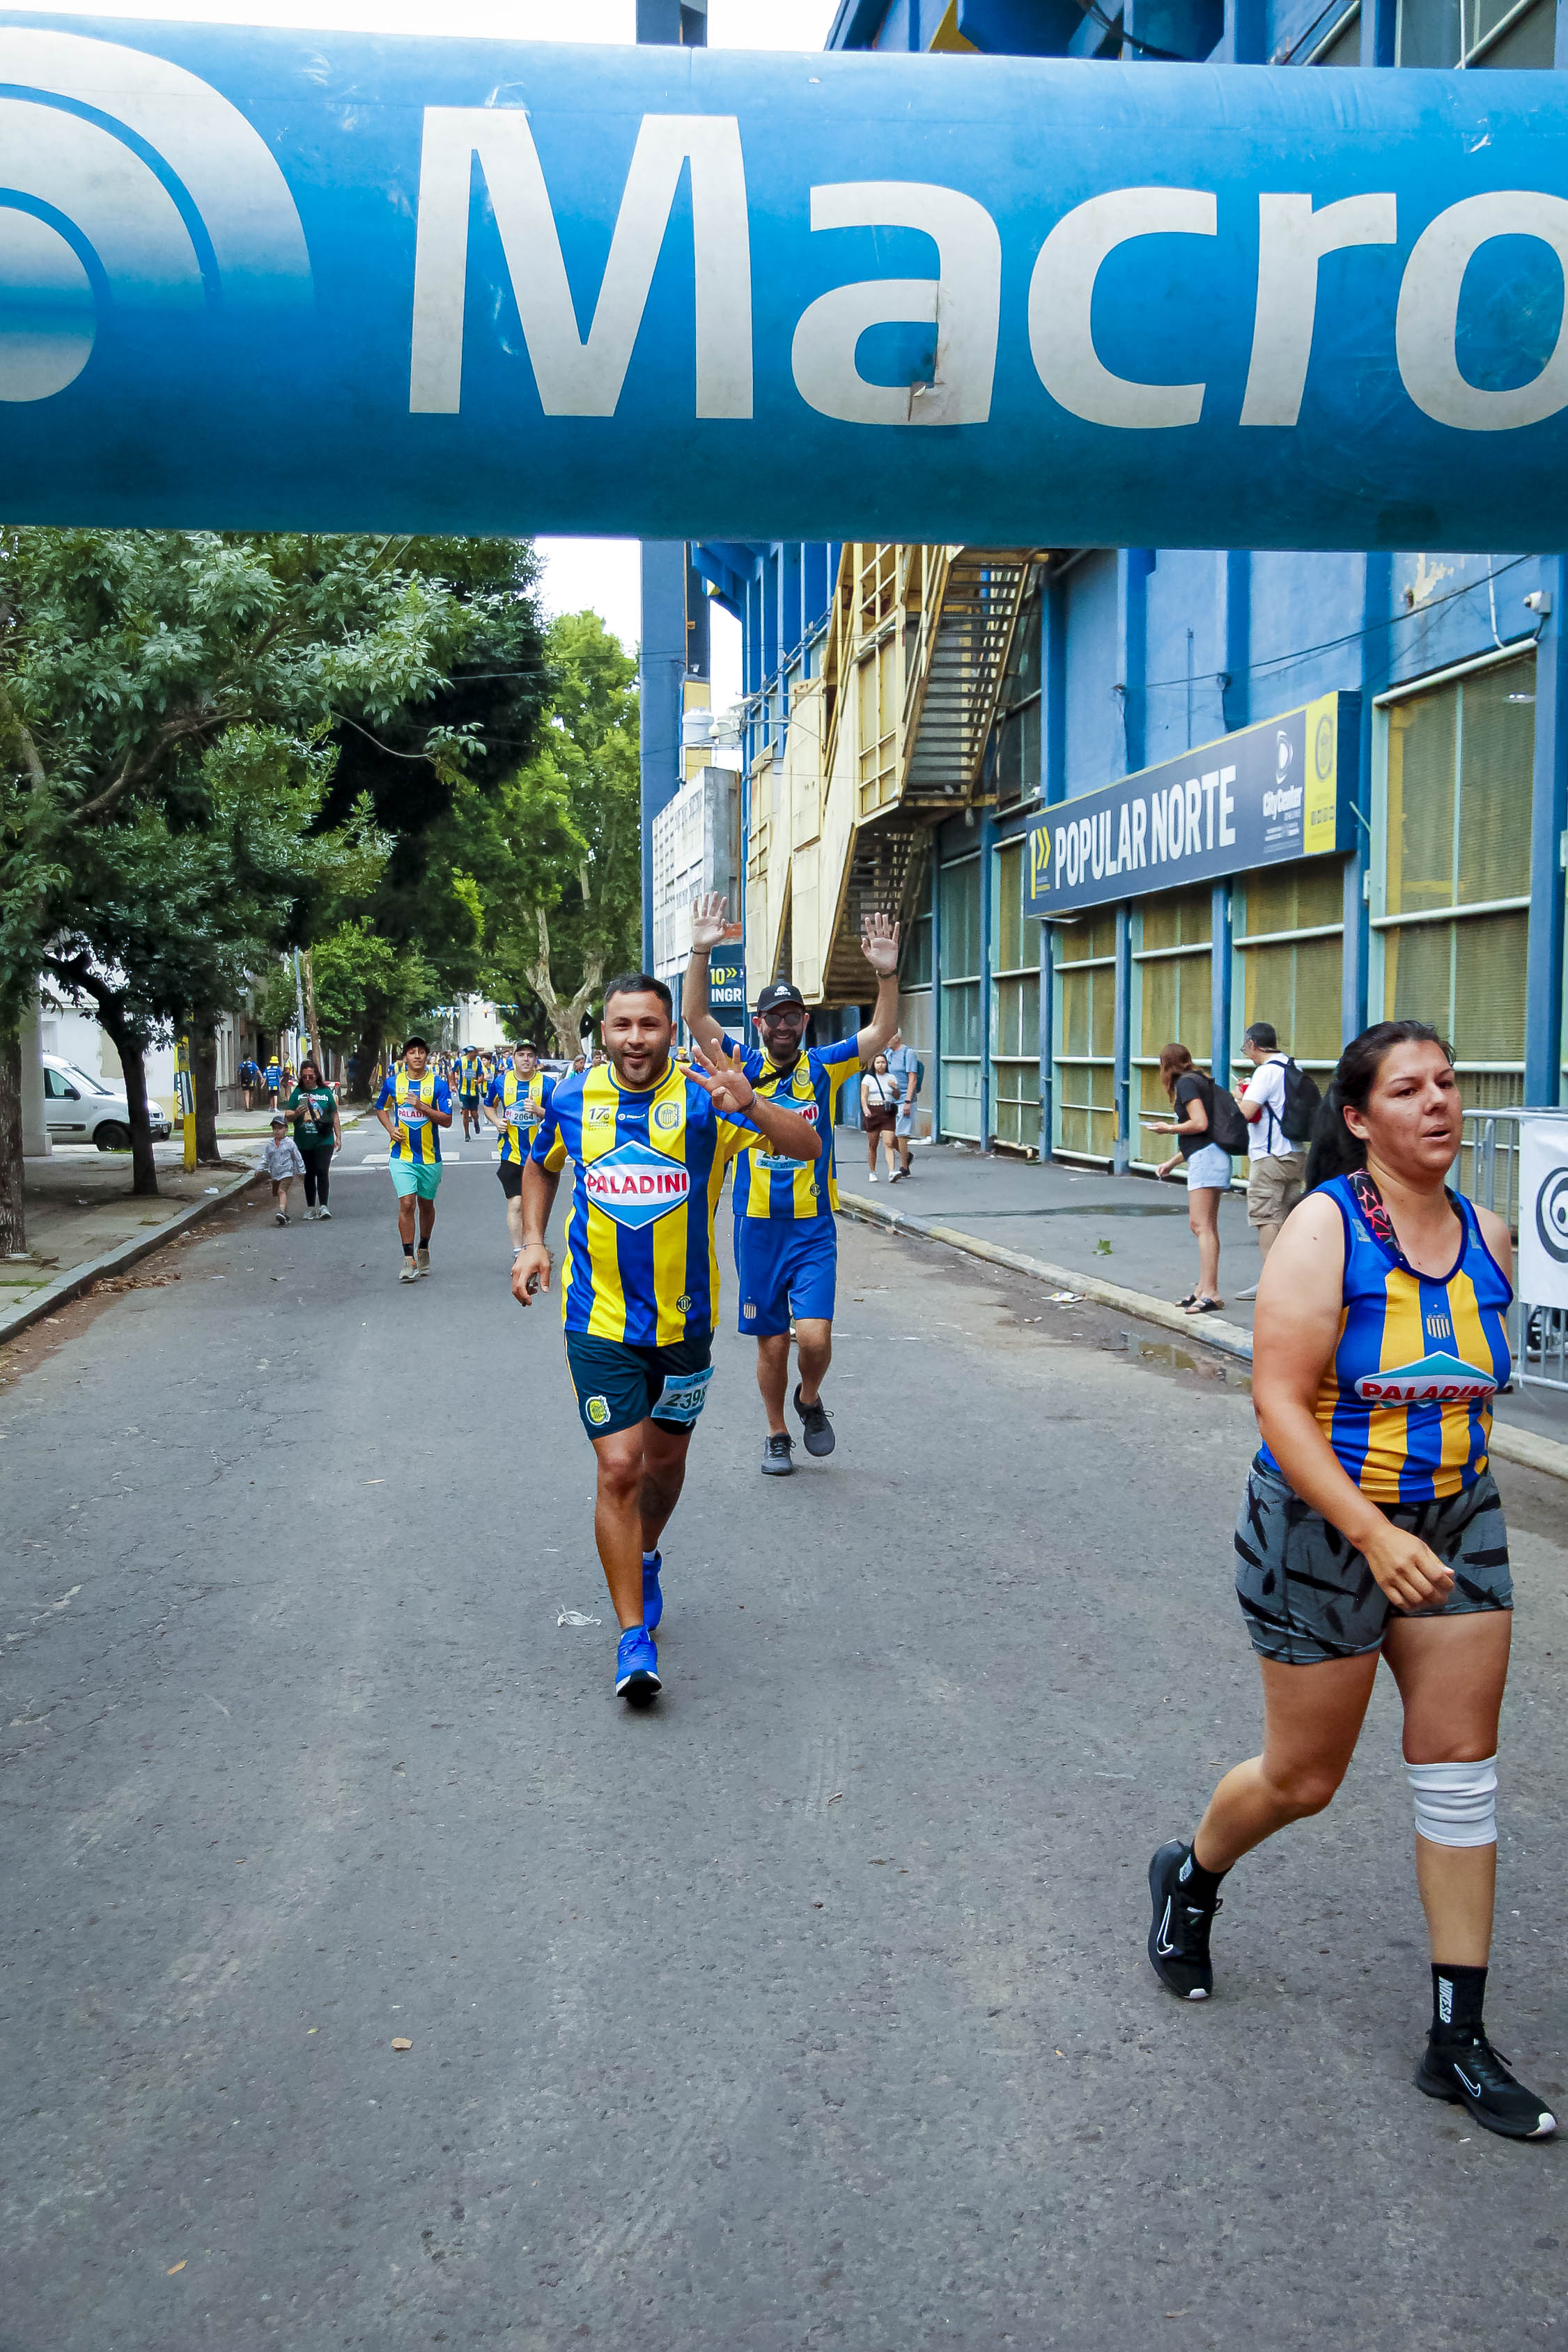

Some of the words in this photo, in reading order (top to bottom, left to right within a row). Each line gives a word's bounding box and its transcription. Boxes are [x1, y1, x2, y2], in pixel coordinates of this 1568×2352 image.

[410, 107, 1568, 431] Macro
[1055, 798, 1147, 890] POPULAR
[1151, 765, 1236, 865] NORTE
[710, 968, 725, 985] 10
[711, 988, 745, 1003] INGR
[514, 1113, 534, 1121] 2064
[587, 1173, 688, 1194] PALADINI
[1362, 1382, 1498, 1400] PALADINI
